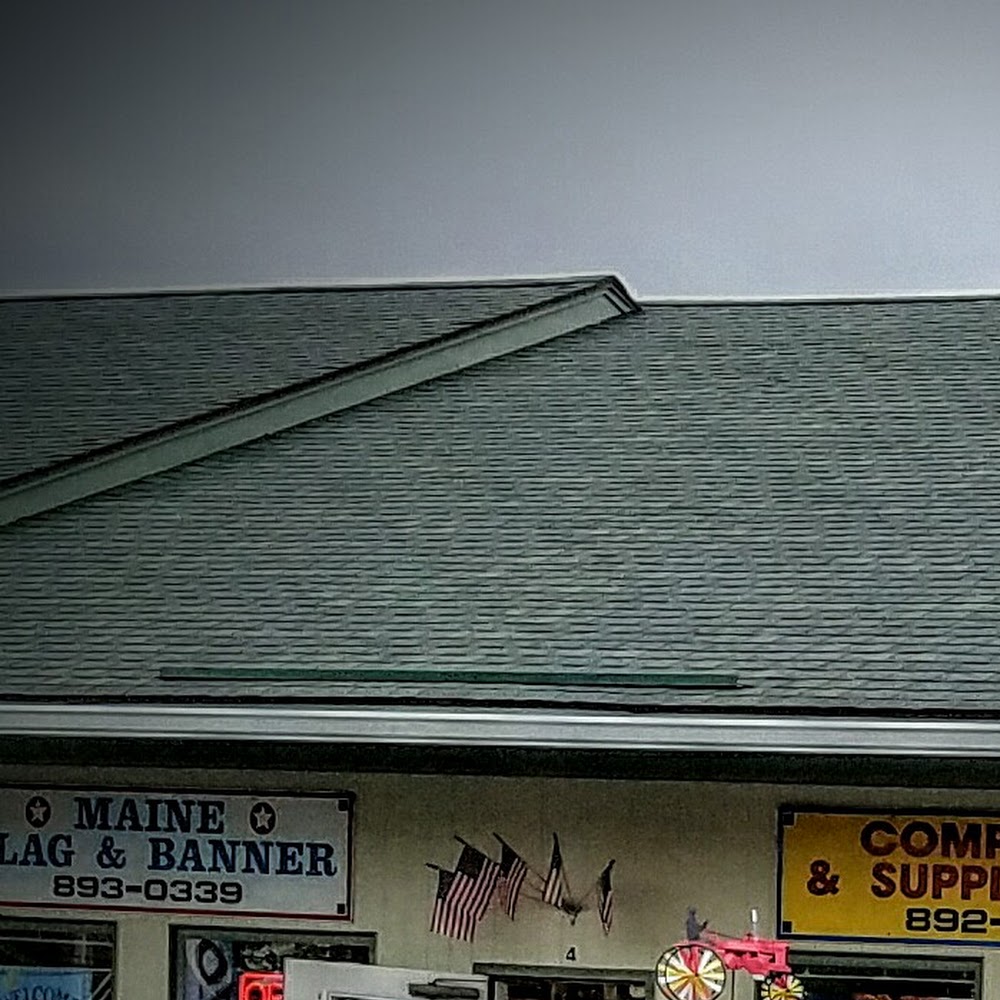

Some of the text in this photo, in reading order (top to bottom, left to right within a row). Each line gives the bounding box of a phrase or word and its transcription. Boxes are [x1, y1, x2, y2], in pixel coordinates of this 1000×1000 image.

[75, 797, 225, 834] MAINE
[96, 837, 126, 869] &
[148, 838, 337, 877] BANNER
[53, 875, 243, 904] 893-0339
[806, 859, 839, 896] &
[566, 947, 577, 961] 4
